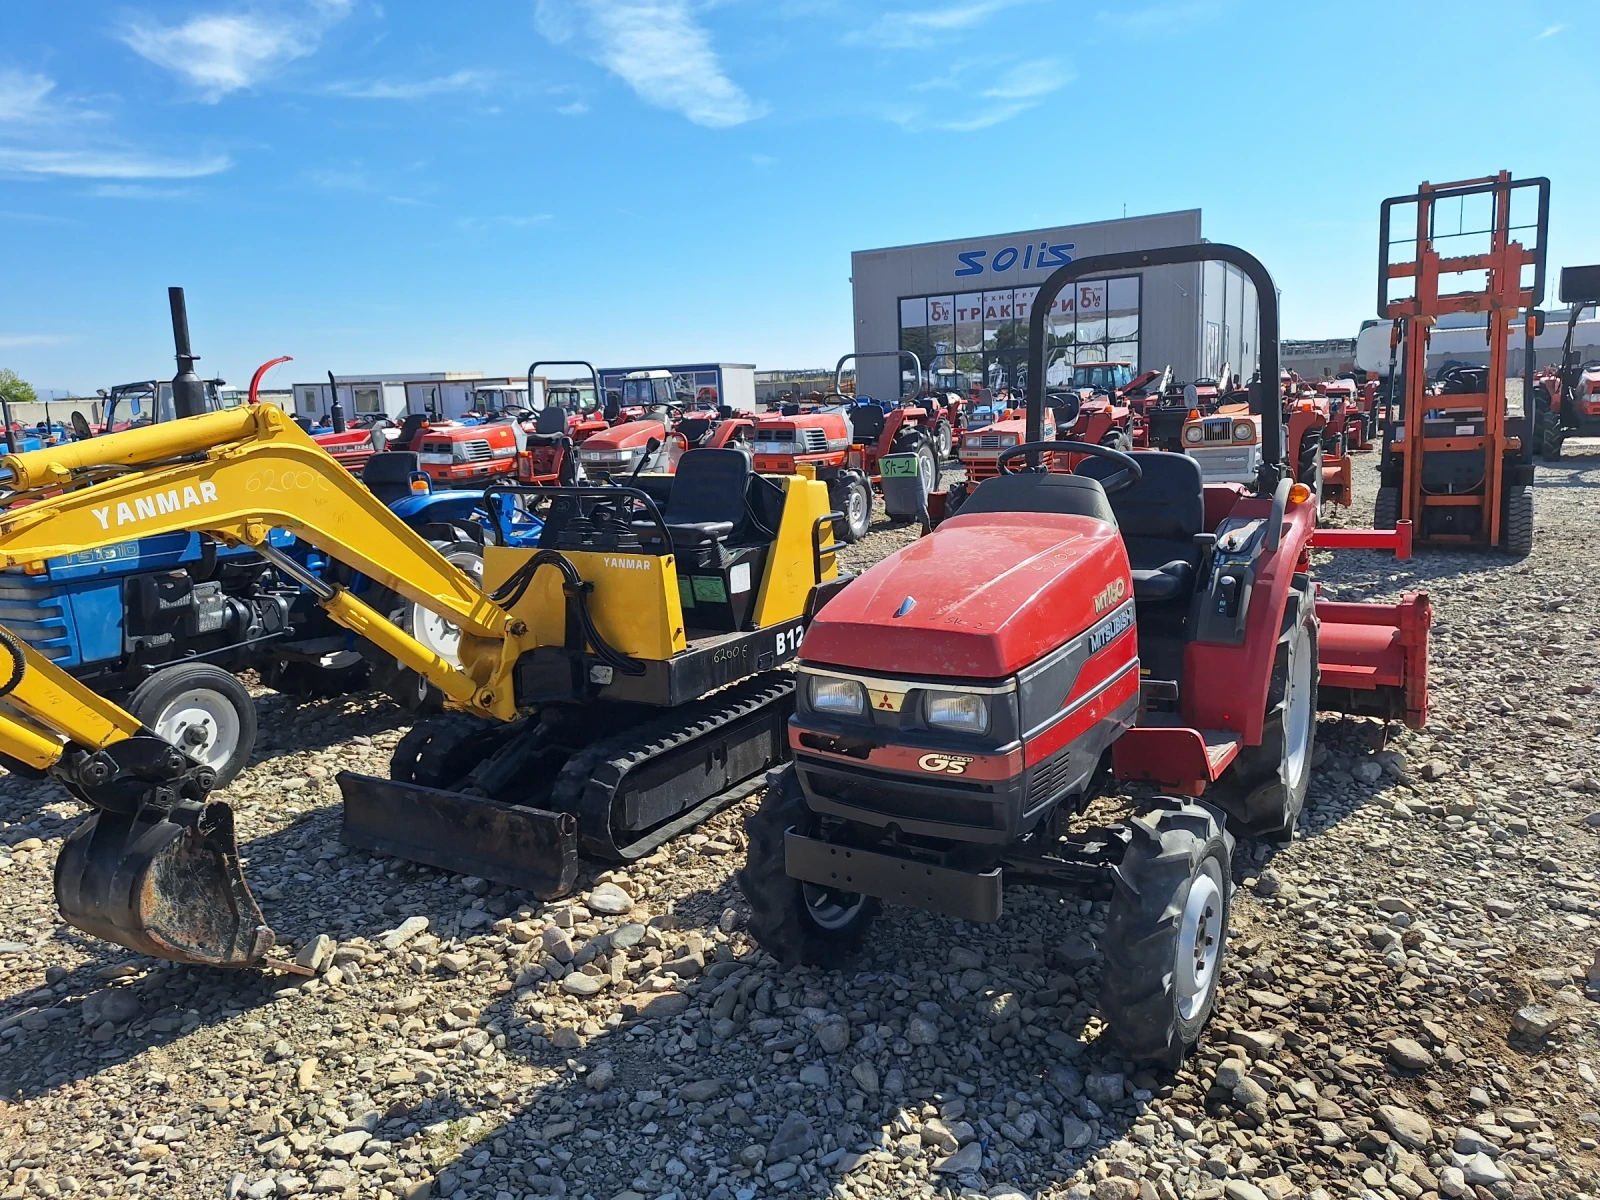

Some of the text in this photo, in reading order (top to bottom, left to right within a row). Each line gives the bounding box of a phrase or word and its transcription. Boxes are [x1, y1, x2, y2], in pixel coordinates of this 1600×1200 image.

[977, 291, 1036, 303] ТЕХНОГРУ
[957, 298, 1074, 321] ТРАКТРИ
[92, 481, 218, 530] YANMAR
[603, 557, 651, 570] YANMAR
[776, 624, 805, 656] B12
[1089, 606, 1134, 653] MITSUBISHI
[918, 752, 967, 774] GS
